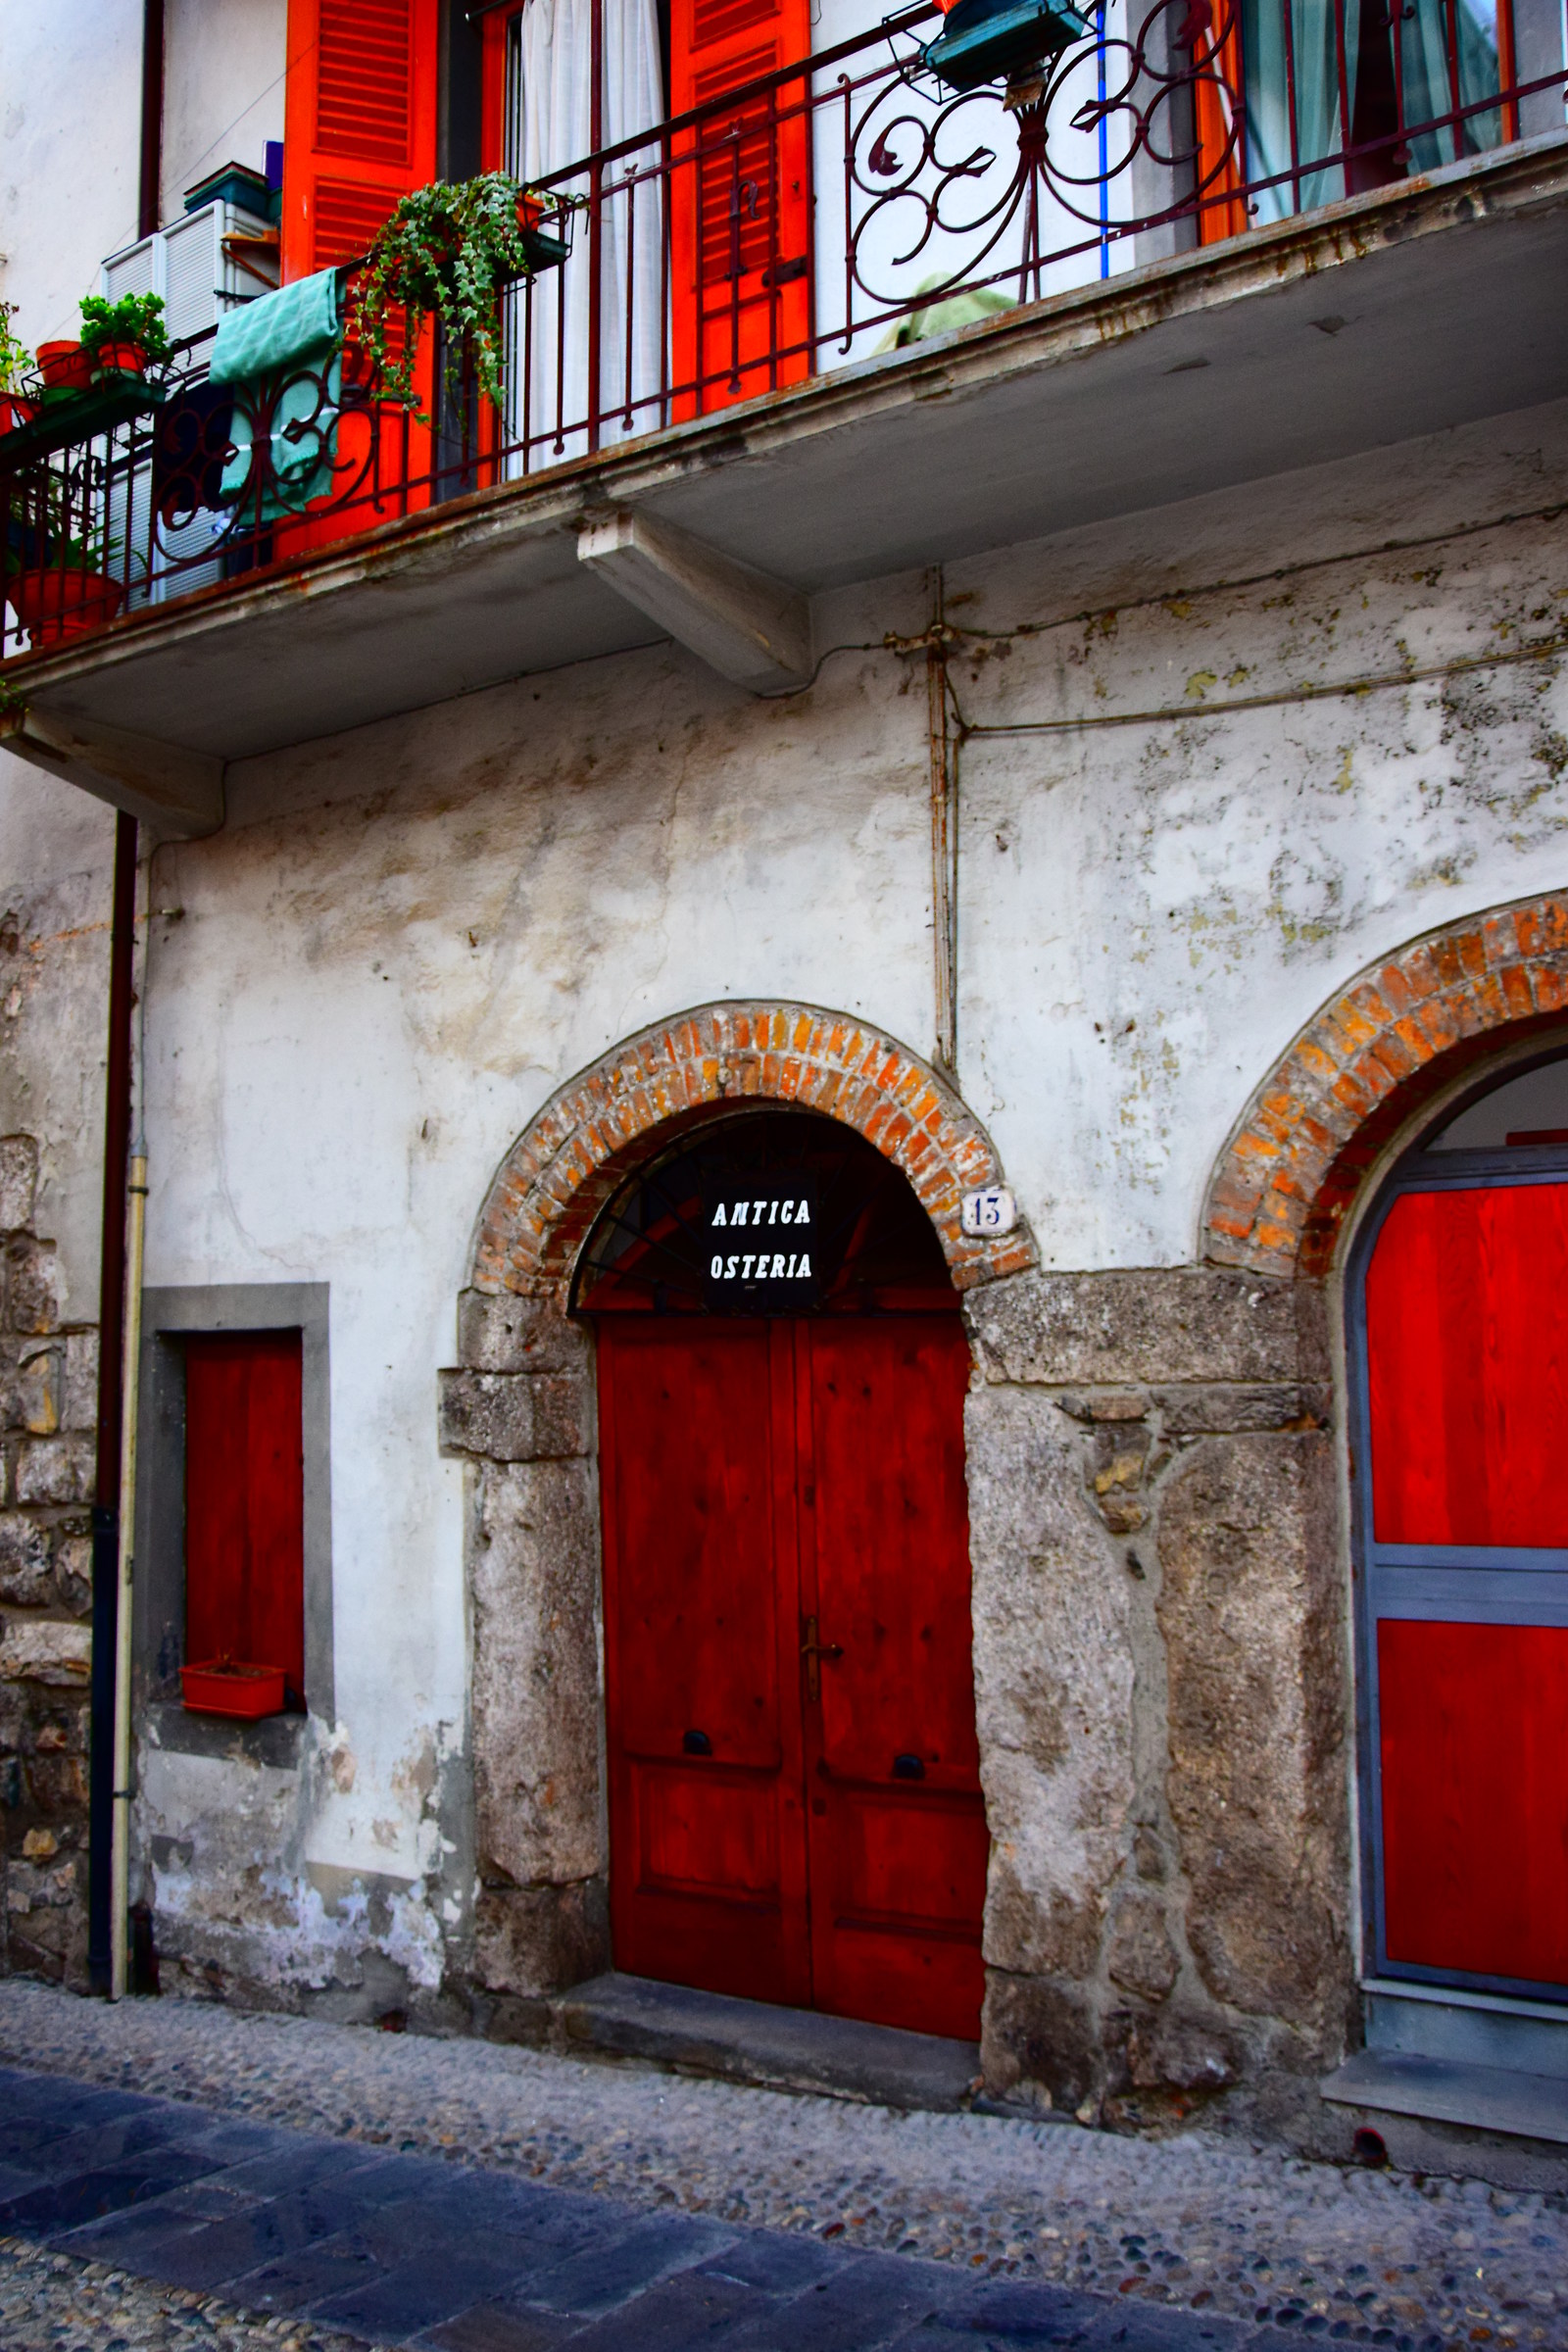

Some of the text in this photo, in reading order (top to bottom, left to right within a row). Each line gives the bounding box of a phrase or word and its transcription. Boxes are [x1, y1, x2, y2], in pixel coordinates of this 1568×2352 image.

[710, 1200, 810, 1227] ANTICA
[975, 1198, 1000, 1225] 13
[710, 1253, 811, 1280] OSTERIA
